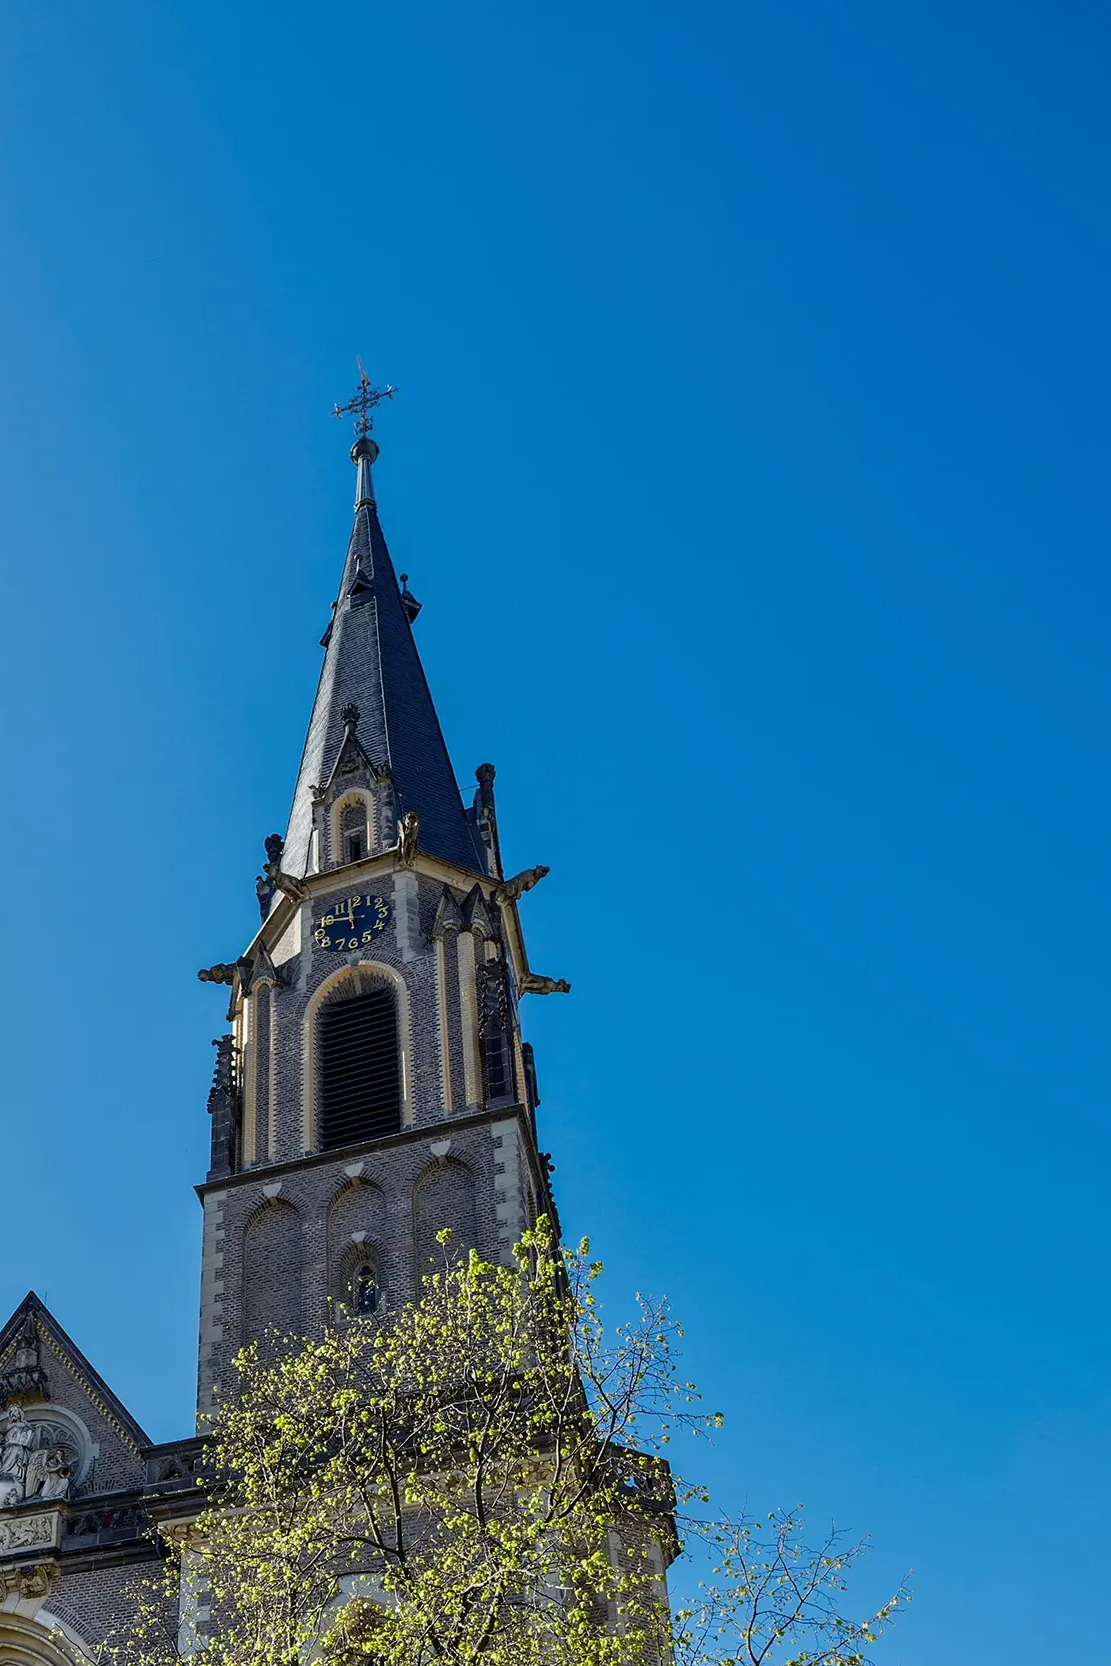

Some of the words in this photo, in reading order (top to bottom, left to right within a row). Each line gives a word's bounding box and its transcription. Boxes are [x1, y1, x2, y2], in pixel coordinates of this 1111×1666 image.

[366, 895, 371, 906] 1
[374, 897, 383, 909] 2
[335, 903, 345, 914] 11
[378, 905, 389, 918] 3
[321, 915, 334, 927] 10
[373, 920, 385, 930] 4
[314, 928, 325, 940] 9
[362, 930, 371, 943] 5
[321, 936, 331, 947] 8
[335, 937, 345, 951] 7
[348, 937, 358, 949] 6
